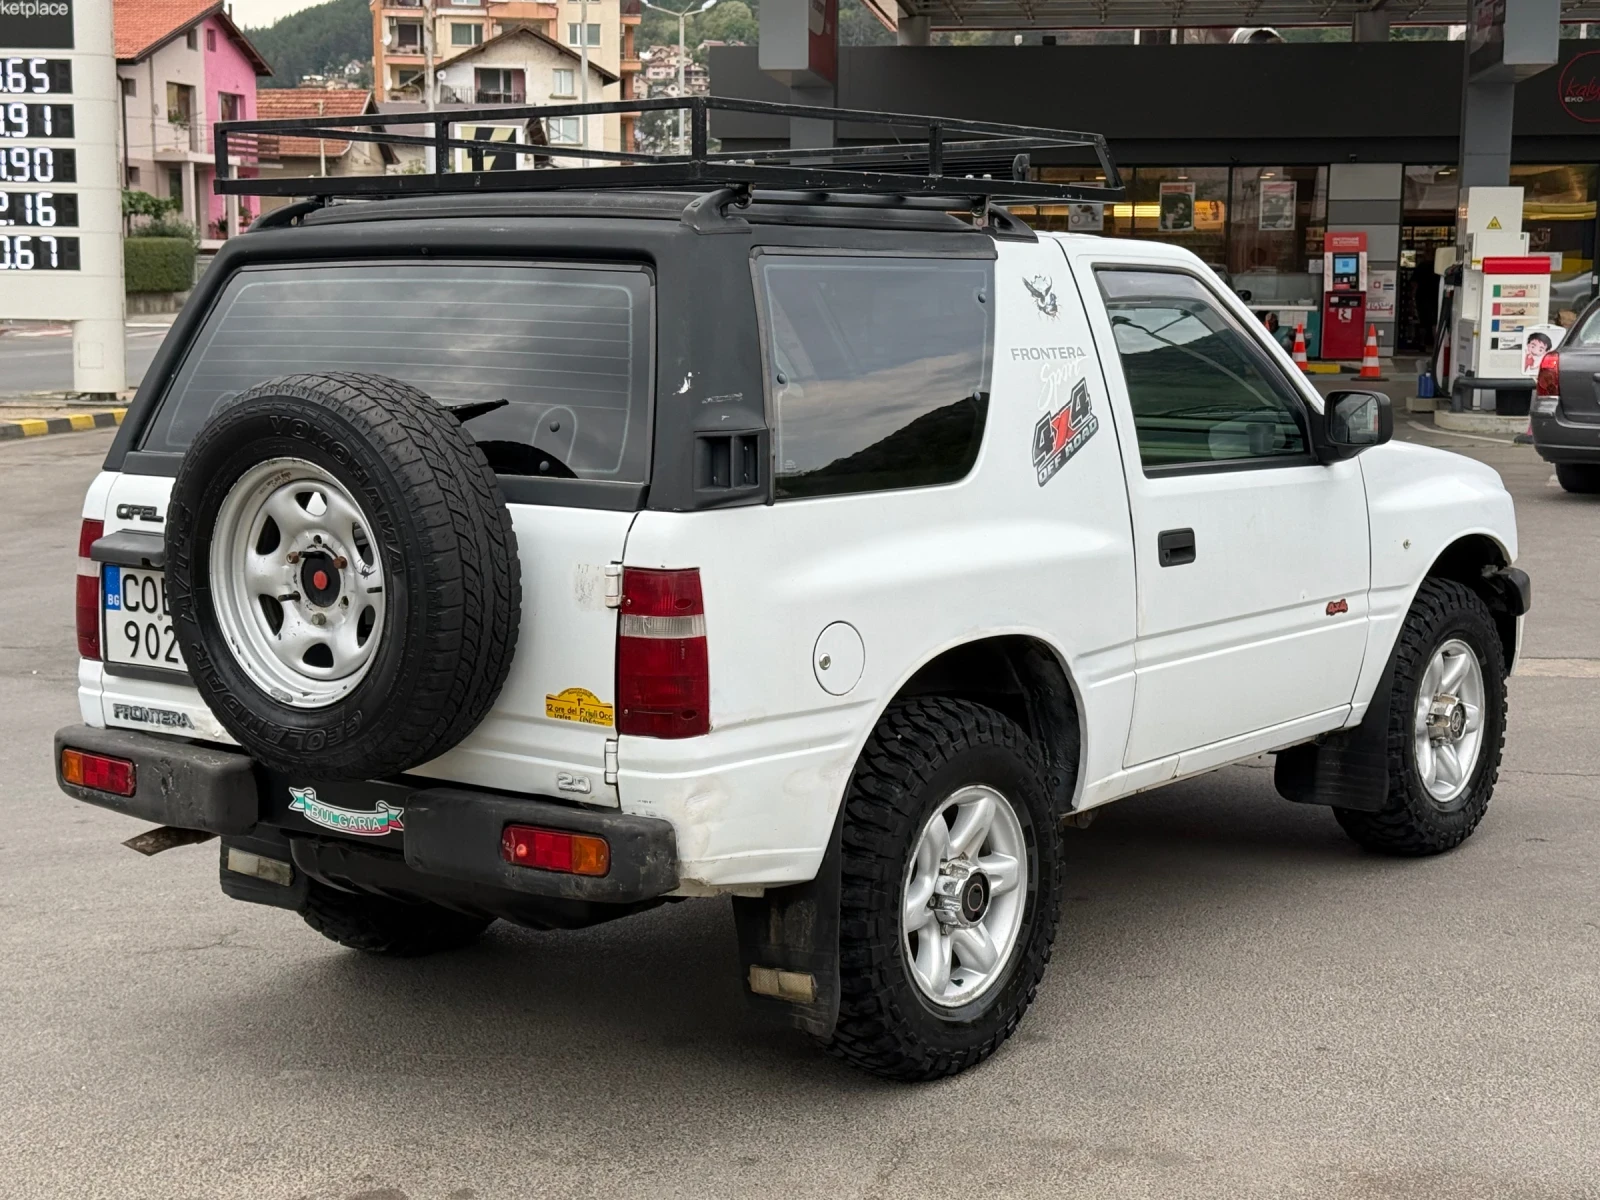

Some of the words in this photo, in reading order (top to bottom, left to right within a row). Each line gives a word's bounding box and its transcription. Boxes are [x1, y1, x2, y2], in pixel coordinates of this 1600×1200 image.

[0, 0, 69, 19] ketplace
[0, 57, 50, 94] .65
[1010, 346, 1086, 362] FRONTERA
[1038, 454, 1063, 484] OFF
[1065, 419, 1098, 458] ROAD
[269, 414, 406, 575] YOKOHAMA
[117, 503, 164, 523] OPEL
[107, 593, 120, 606] BG
[124, 620, 179, 664] 902
[190, 642, 363, 752] GEOLANDAR
[554, 706, 565, 714] ore
[567, 706, 577, 715] del
[113, 703, 195, 730] FRONTERA
[310, 804, 382, 831] BULGARIA
